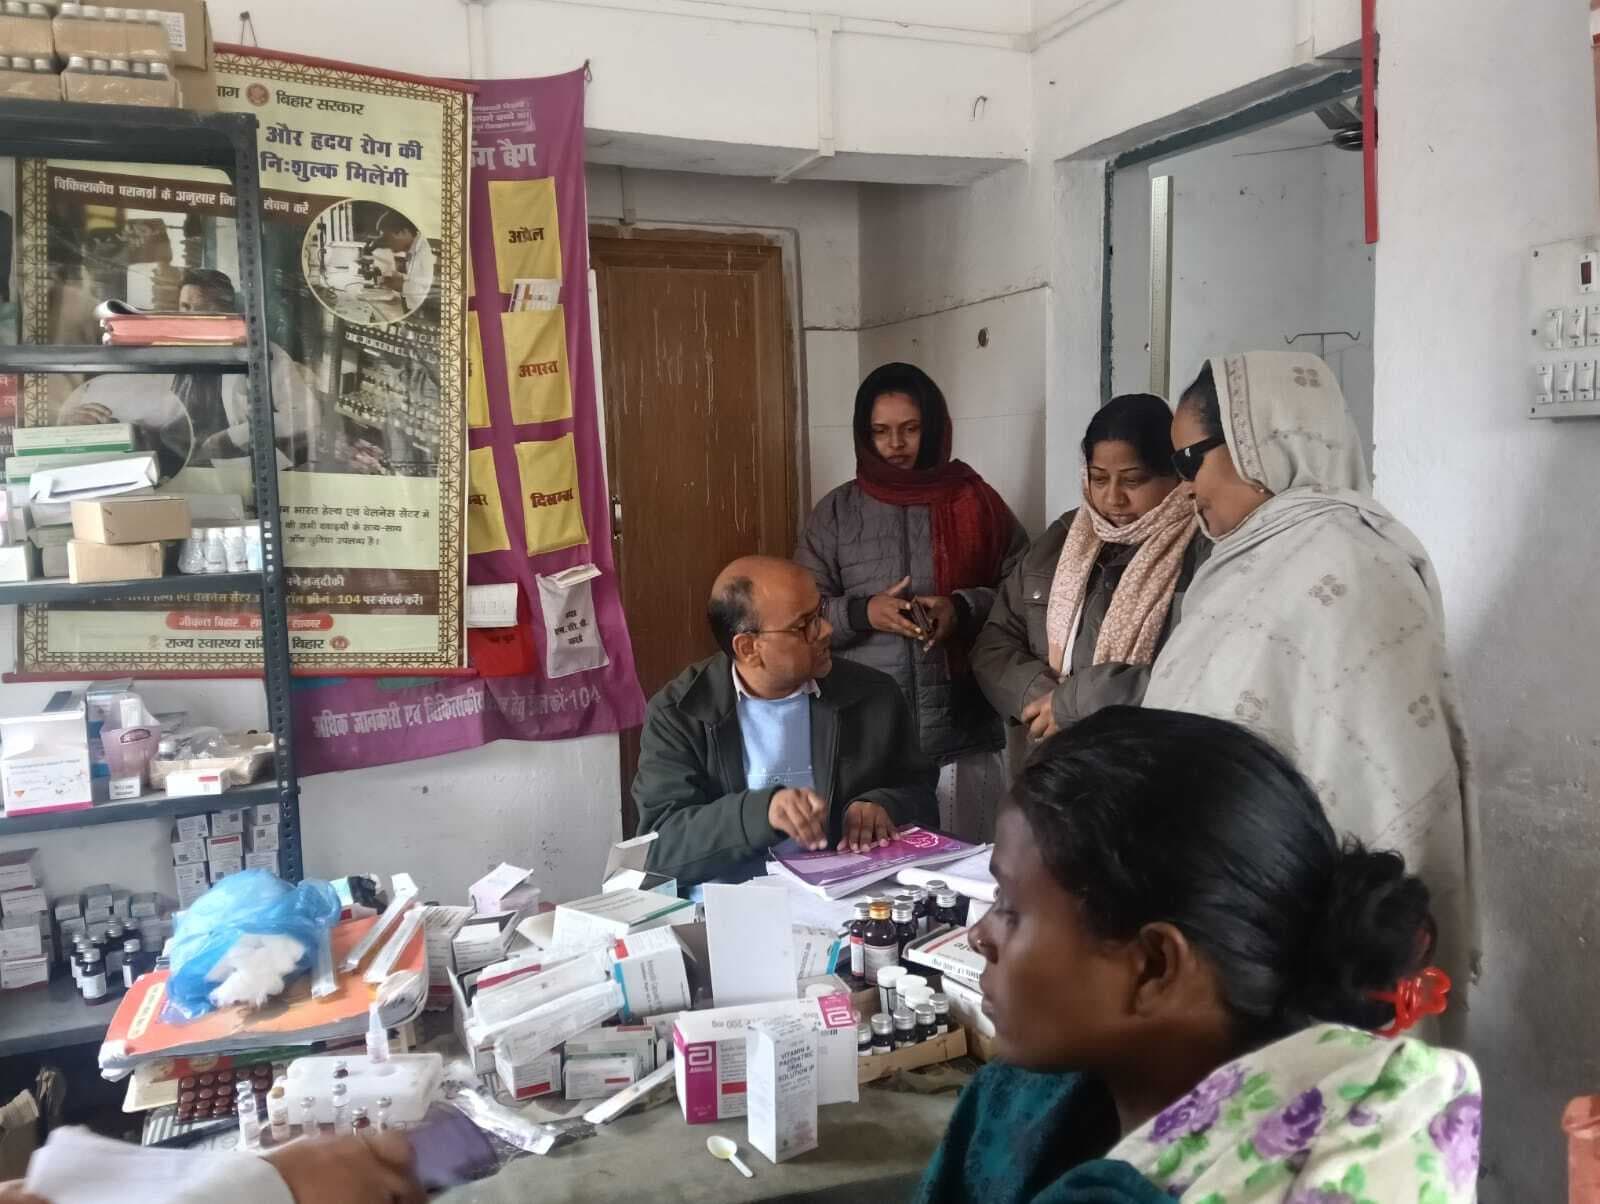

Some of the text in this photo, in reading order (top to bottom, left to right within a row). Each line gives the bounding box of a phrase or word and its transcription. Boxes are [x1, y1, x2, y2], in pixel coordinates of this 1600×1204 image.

[276, 89, 313, 109] बिहार
[316, 98, 366, 115] सरकार
[266, 122, 423, 161] और हृदय रोग की
[497, 137, 537, 168] बैग
[346, 160, 409, 188] मिलेंगी
[161, 187, 171, 200] के
[518, 360, 559, 378] अगस्त
[336, 593, 361, 605] 104
[165, 638, 194, 650] राज्य
[291, 637, 325, 650] बिहार
[781, 1047, 805, 1060] VITAMIN
